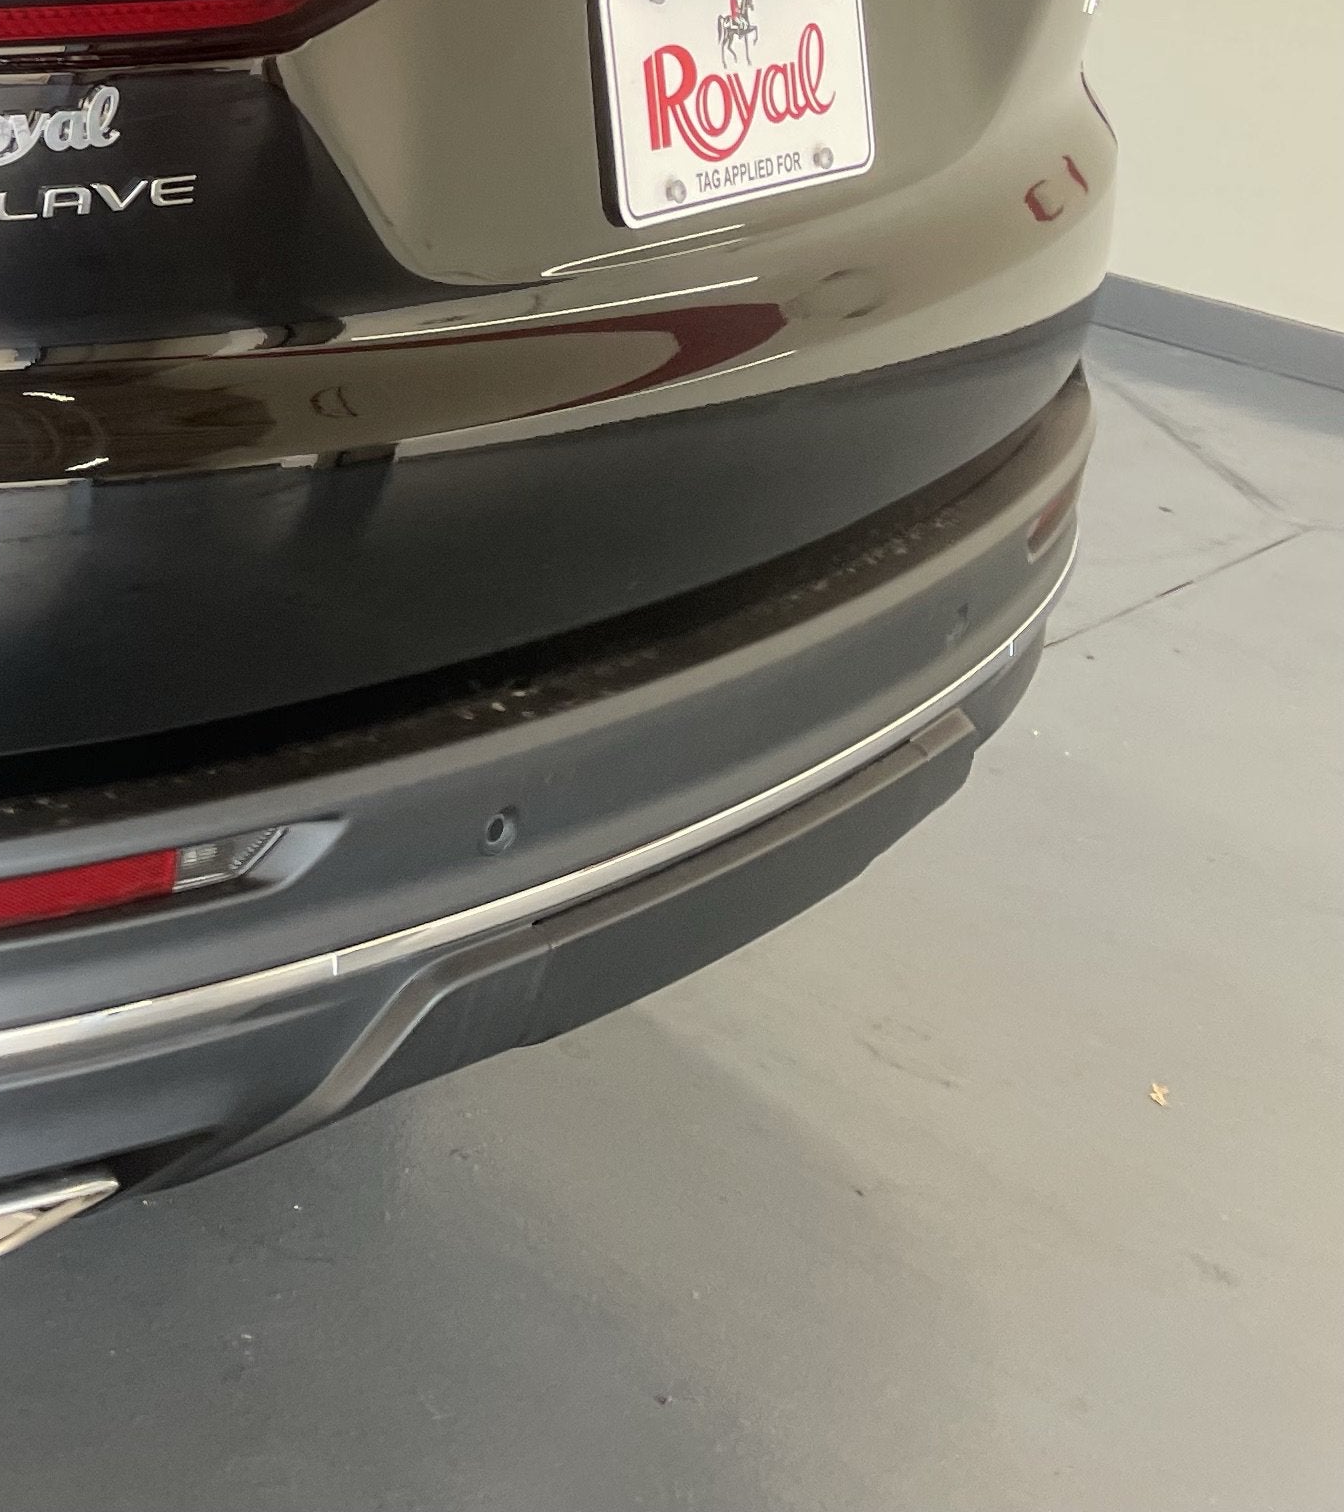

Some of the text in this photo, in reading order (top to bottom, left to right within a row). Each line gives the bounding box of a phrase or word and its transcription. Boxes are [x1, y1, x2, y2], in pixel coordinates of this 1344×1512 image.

[643, 22, 837, 163] Royal
[696, 151, 802, 193] TAG APPLIED FOR
